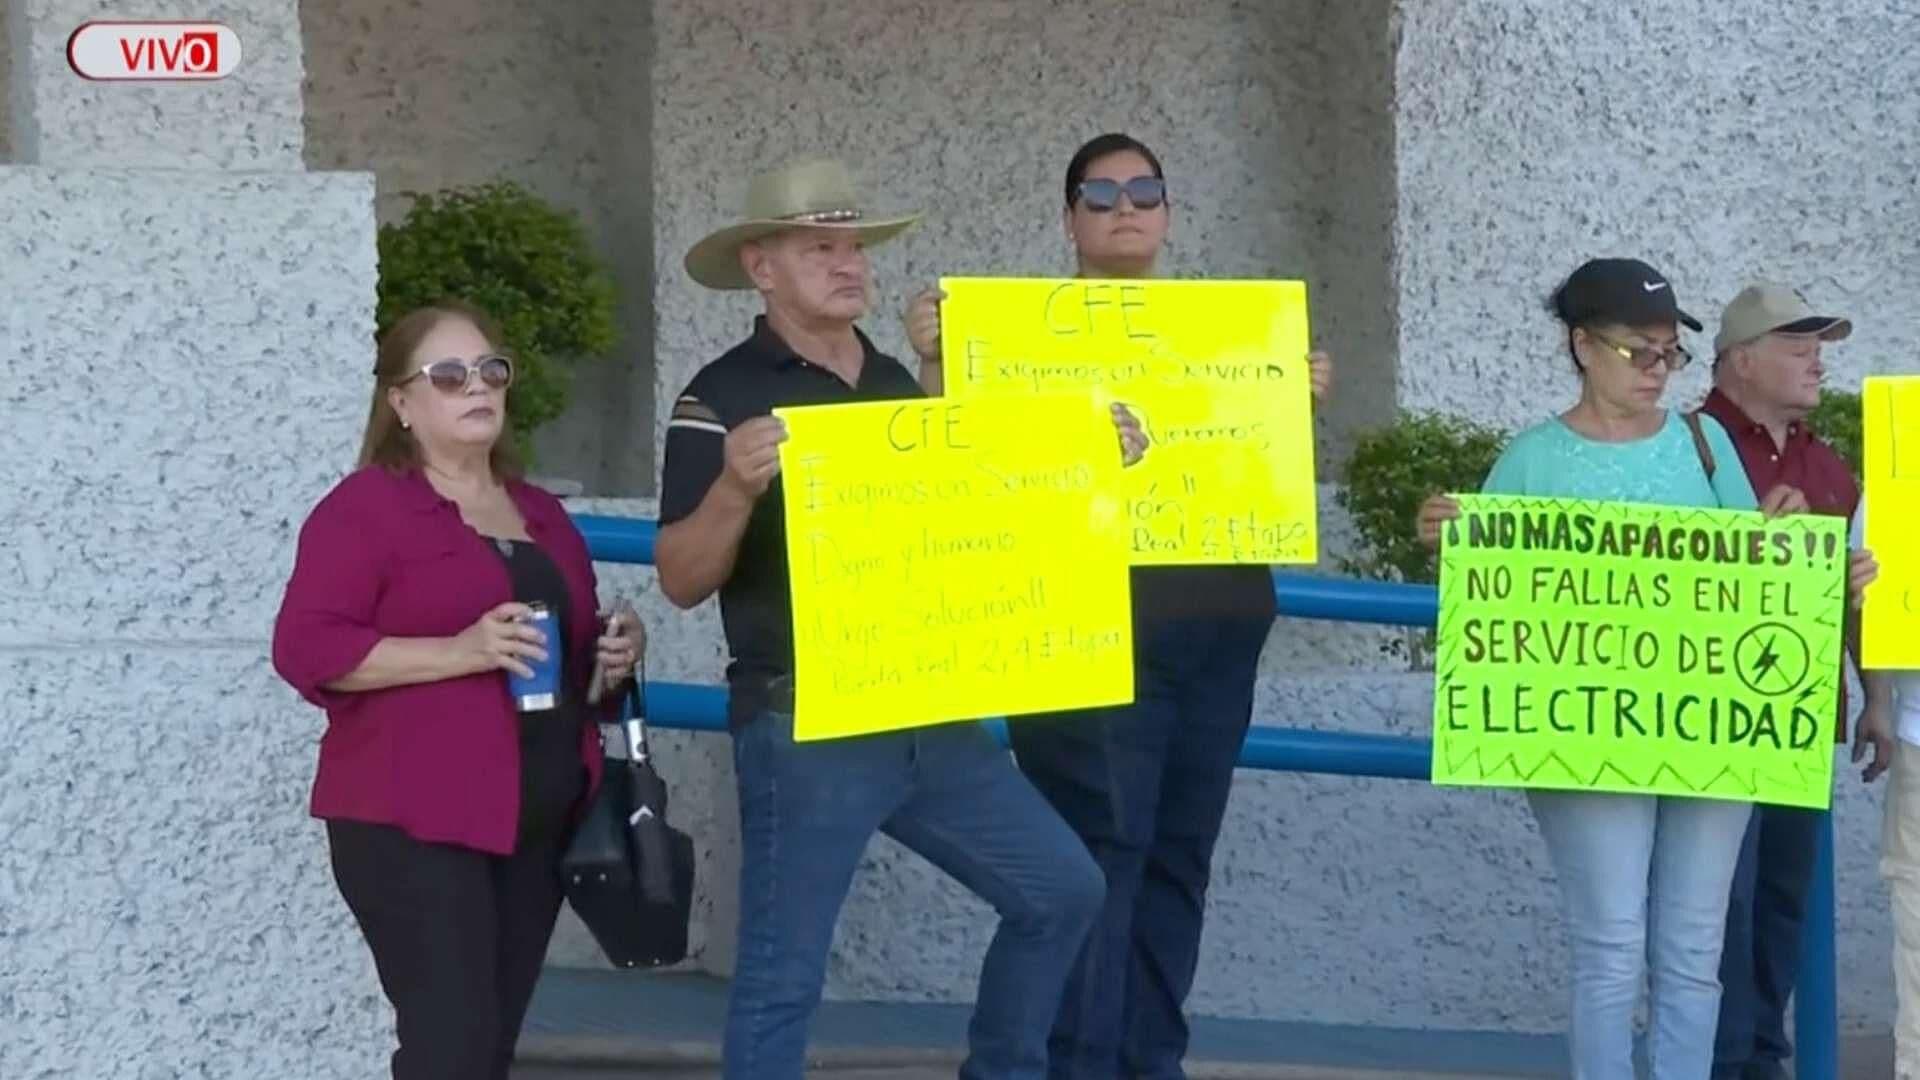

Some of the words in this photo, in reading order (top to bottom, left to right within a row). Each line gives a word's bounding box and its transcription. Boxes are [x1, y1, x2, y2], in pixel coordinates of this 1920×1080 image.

[1044, 283, 1156, 338] CFE
[887, 404, 972, 452] CFE
[1467, 564, 1512, 601] NO
[1531, 566, 1671, 609] FALLAS
[1694, 576, 1740, 613] EN
[1760, 580, 1799, 617] EL
[1464, 618, 1659, 671] SERVICIO
[1678, 632, 1726, 675] DE
[1447, 684, 1818, 751] ELECTRICIDAD
